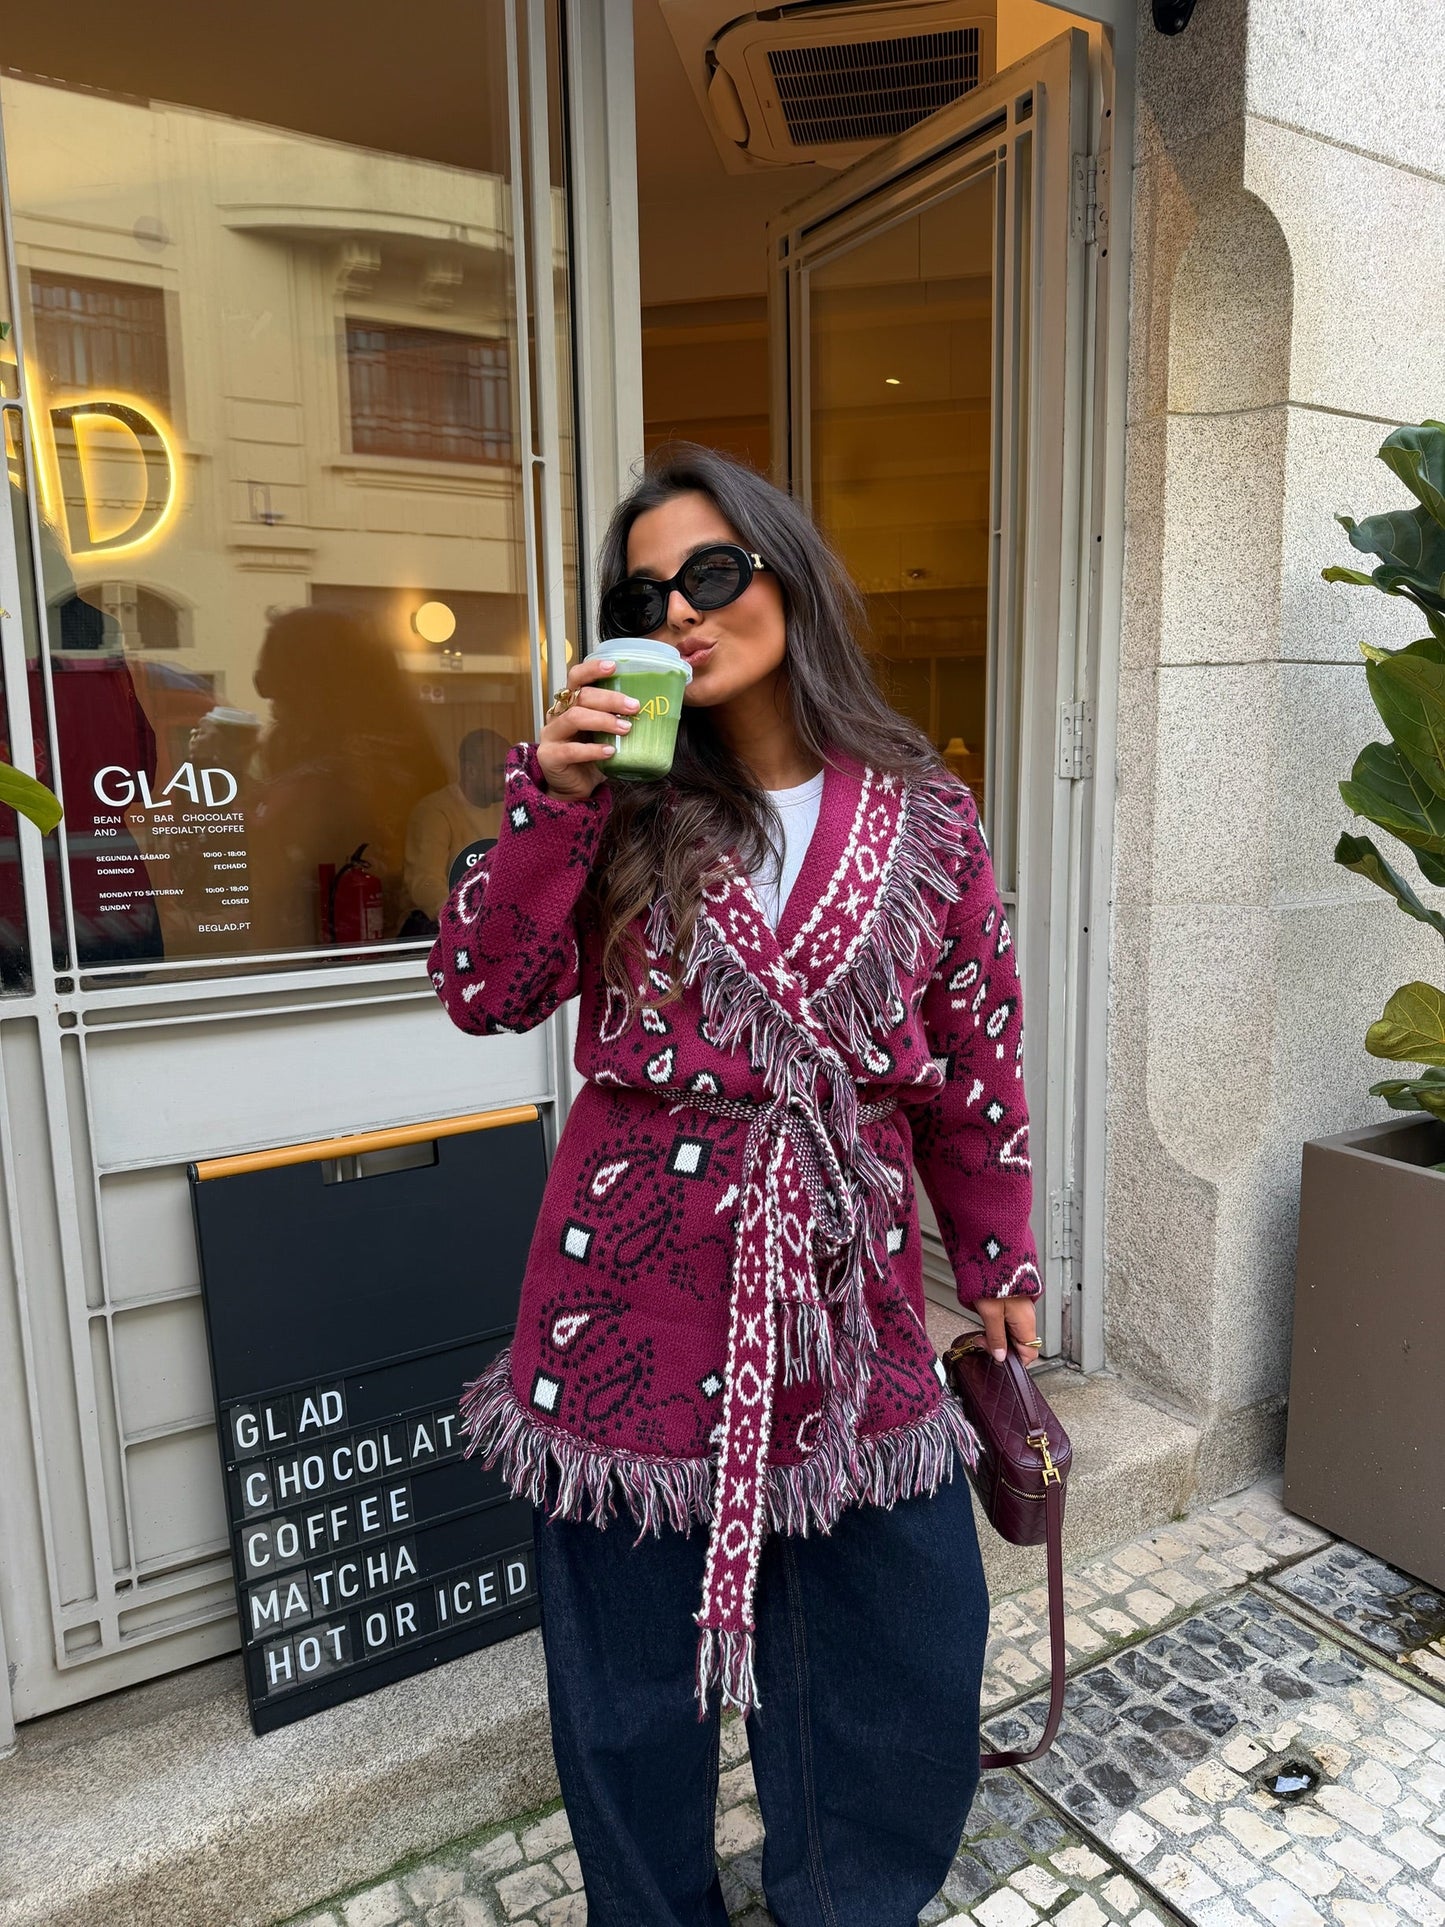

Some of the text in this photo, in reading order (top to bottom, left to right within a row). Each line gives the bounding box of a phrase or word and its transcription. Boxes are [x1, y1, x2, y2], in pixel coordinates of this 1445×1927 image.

[93, 761, 238, 809] GLAD
[93, 812, 244, 825] BEAN TO BAR CHOCOLATE
[94, 824, 245, 837] AND SPECIALTY COFFEE
[97, 867, 135, 875] DOMINGO
[213, 862, 247, 870] FECHADO
[99, 891, 132, 899] MONDAY
[221, 897, 249, 905] CLOSED
[100, 904, 131, 912] SUNDAY
[198, 921, 251, 932] BEGLAD.PT
[235, 1390, 343, 1449] GLAD
[245, 1414, 456, 1507] CHOCOLAT
[247, 1487, 410, 1567] COFFEE
[251, 1545, 417, 1630] MATCHA
[268, 1562, 527, 1685] HOT OR ICED
